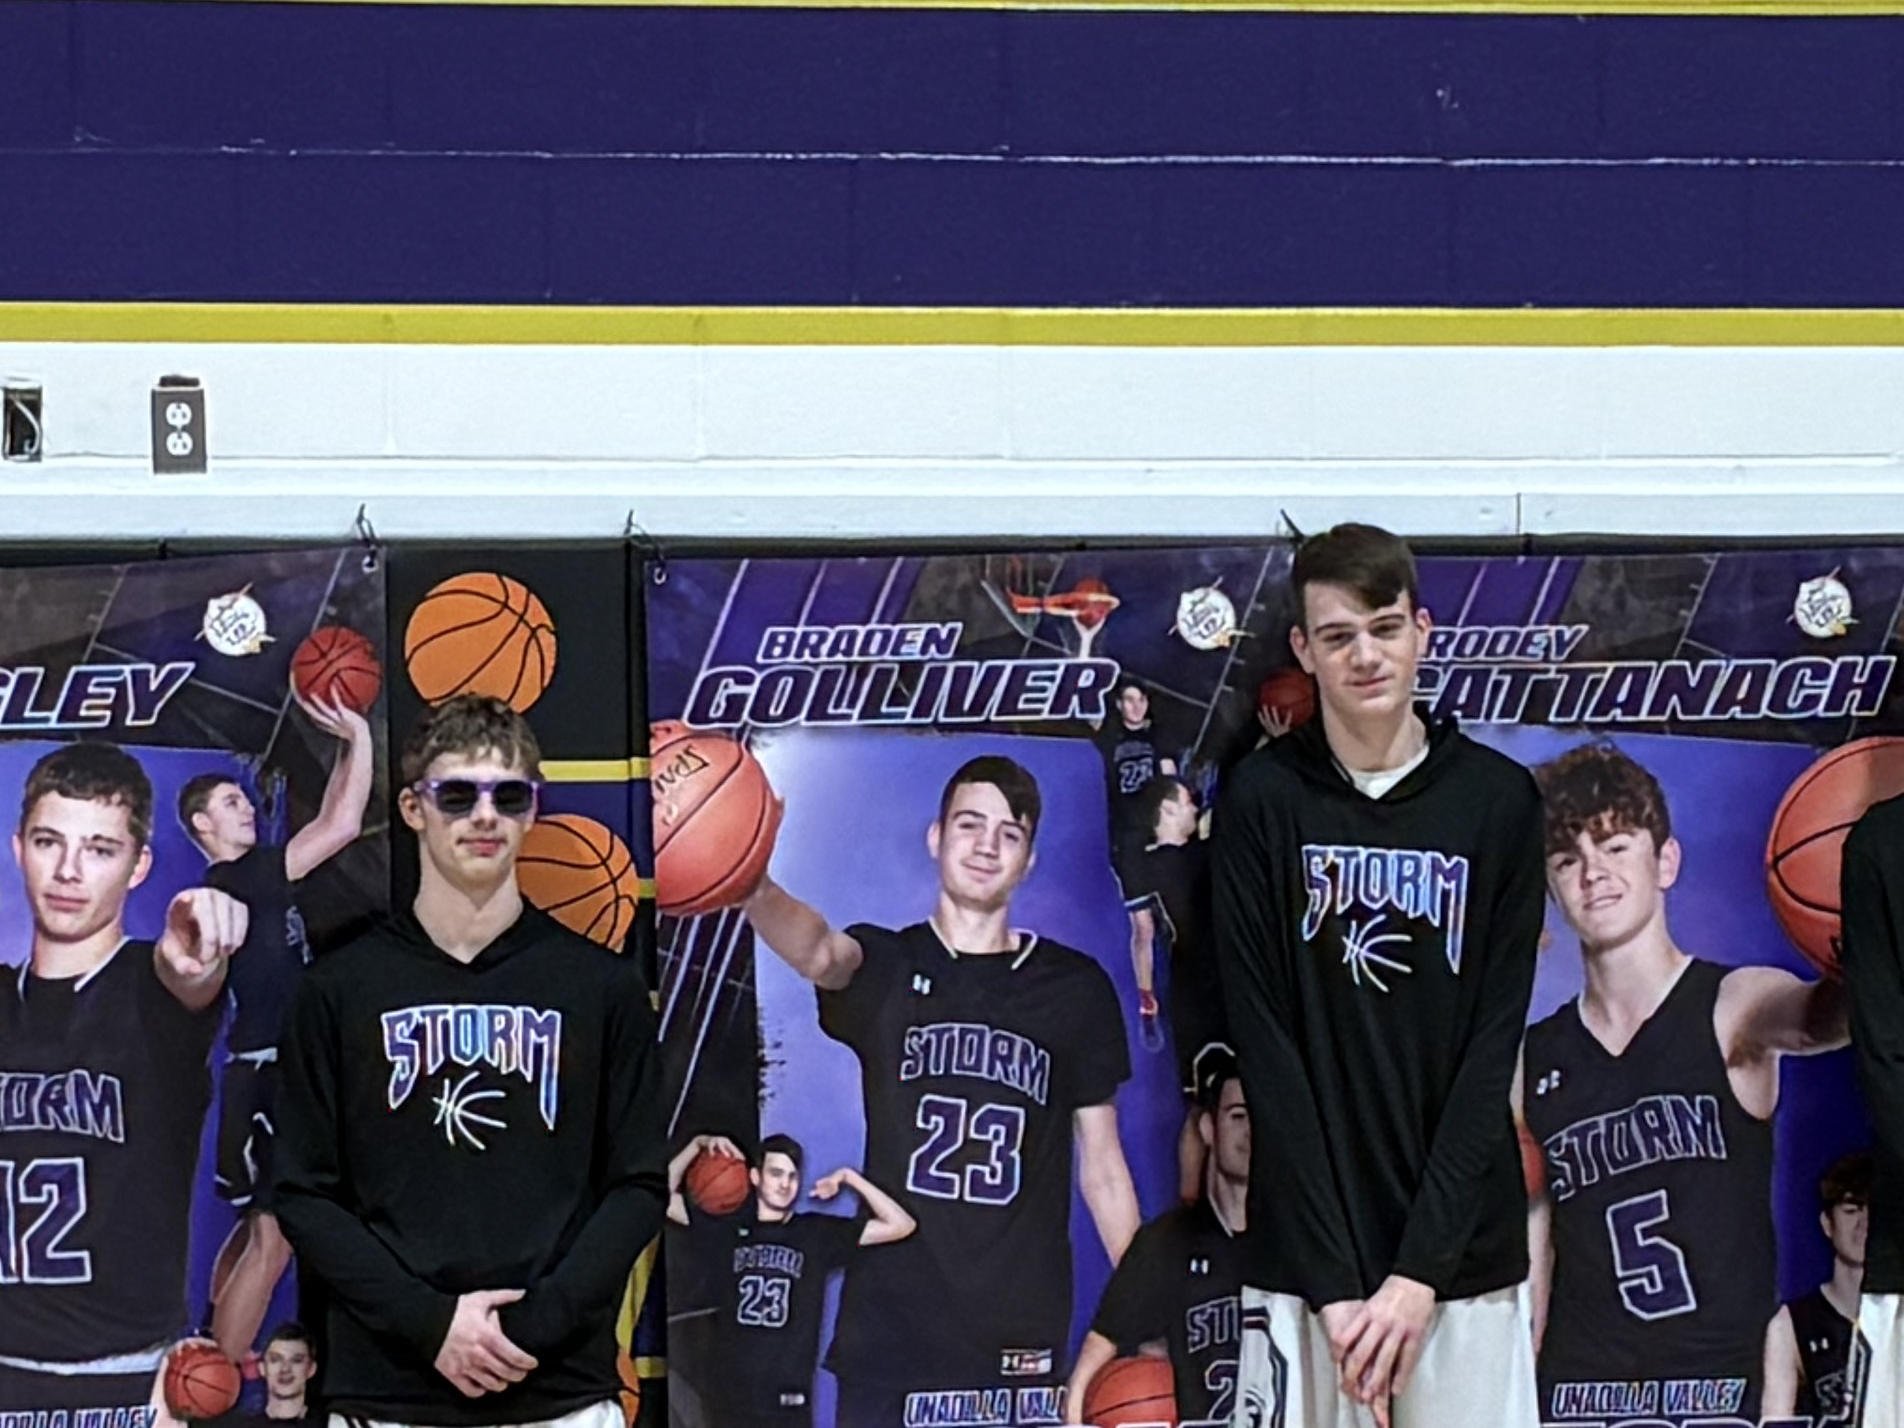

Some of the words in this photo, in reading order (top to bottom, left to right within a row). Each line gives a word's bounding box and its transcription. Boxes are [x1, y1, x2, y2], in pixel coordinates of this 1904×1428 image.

[756, 622, 963, 664] BRADEN
[1426, 625, 1589, 663] RODEY
[683, 658, 1119, 729] GOLLIVER
[1301, 844, 1469, 976] STORM
[381, 1004, 562, 1132] STORM
[900, 1023, 1052, 1106] STORM
[906, 1093, 1028, 1206] 23
[1543, 1094, 1728, 1202] STORM
[737, 1275, 791, 1328] 23
[1604, 1188, 1696, 1322] 5
